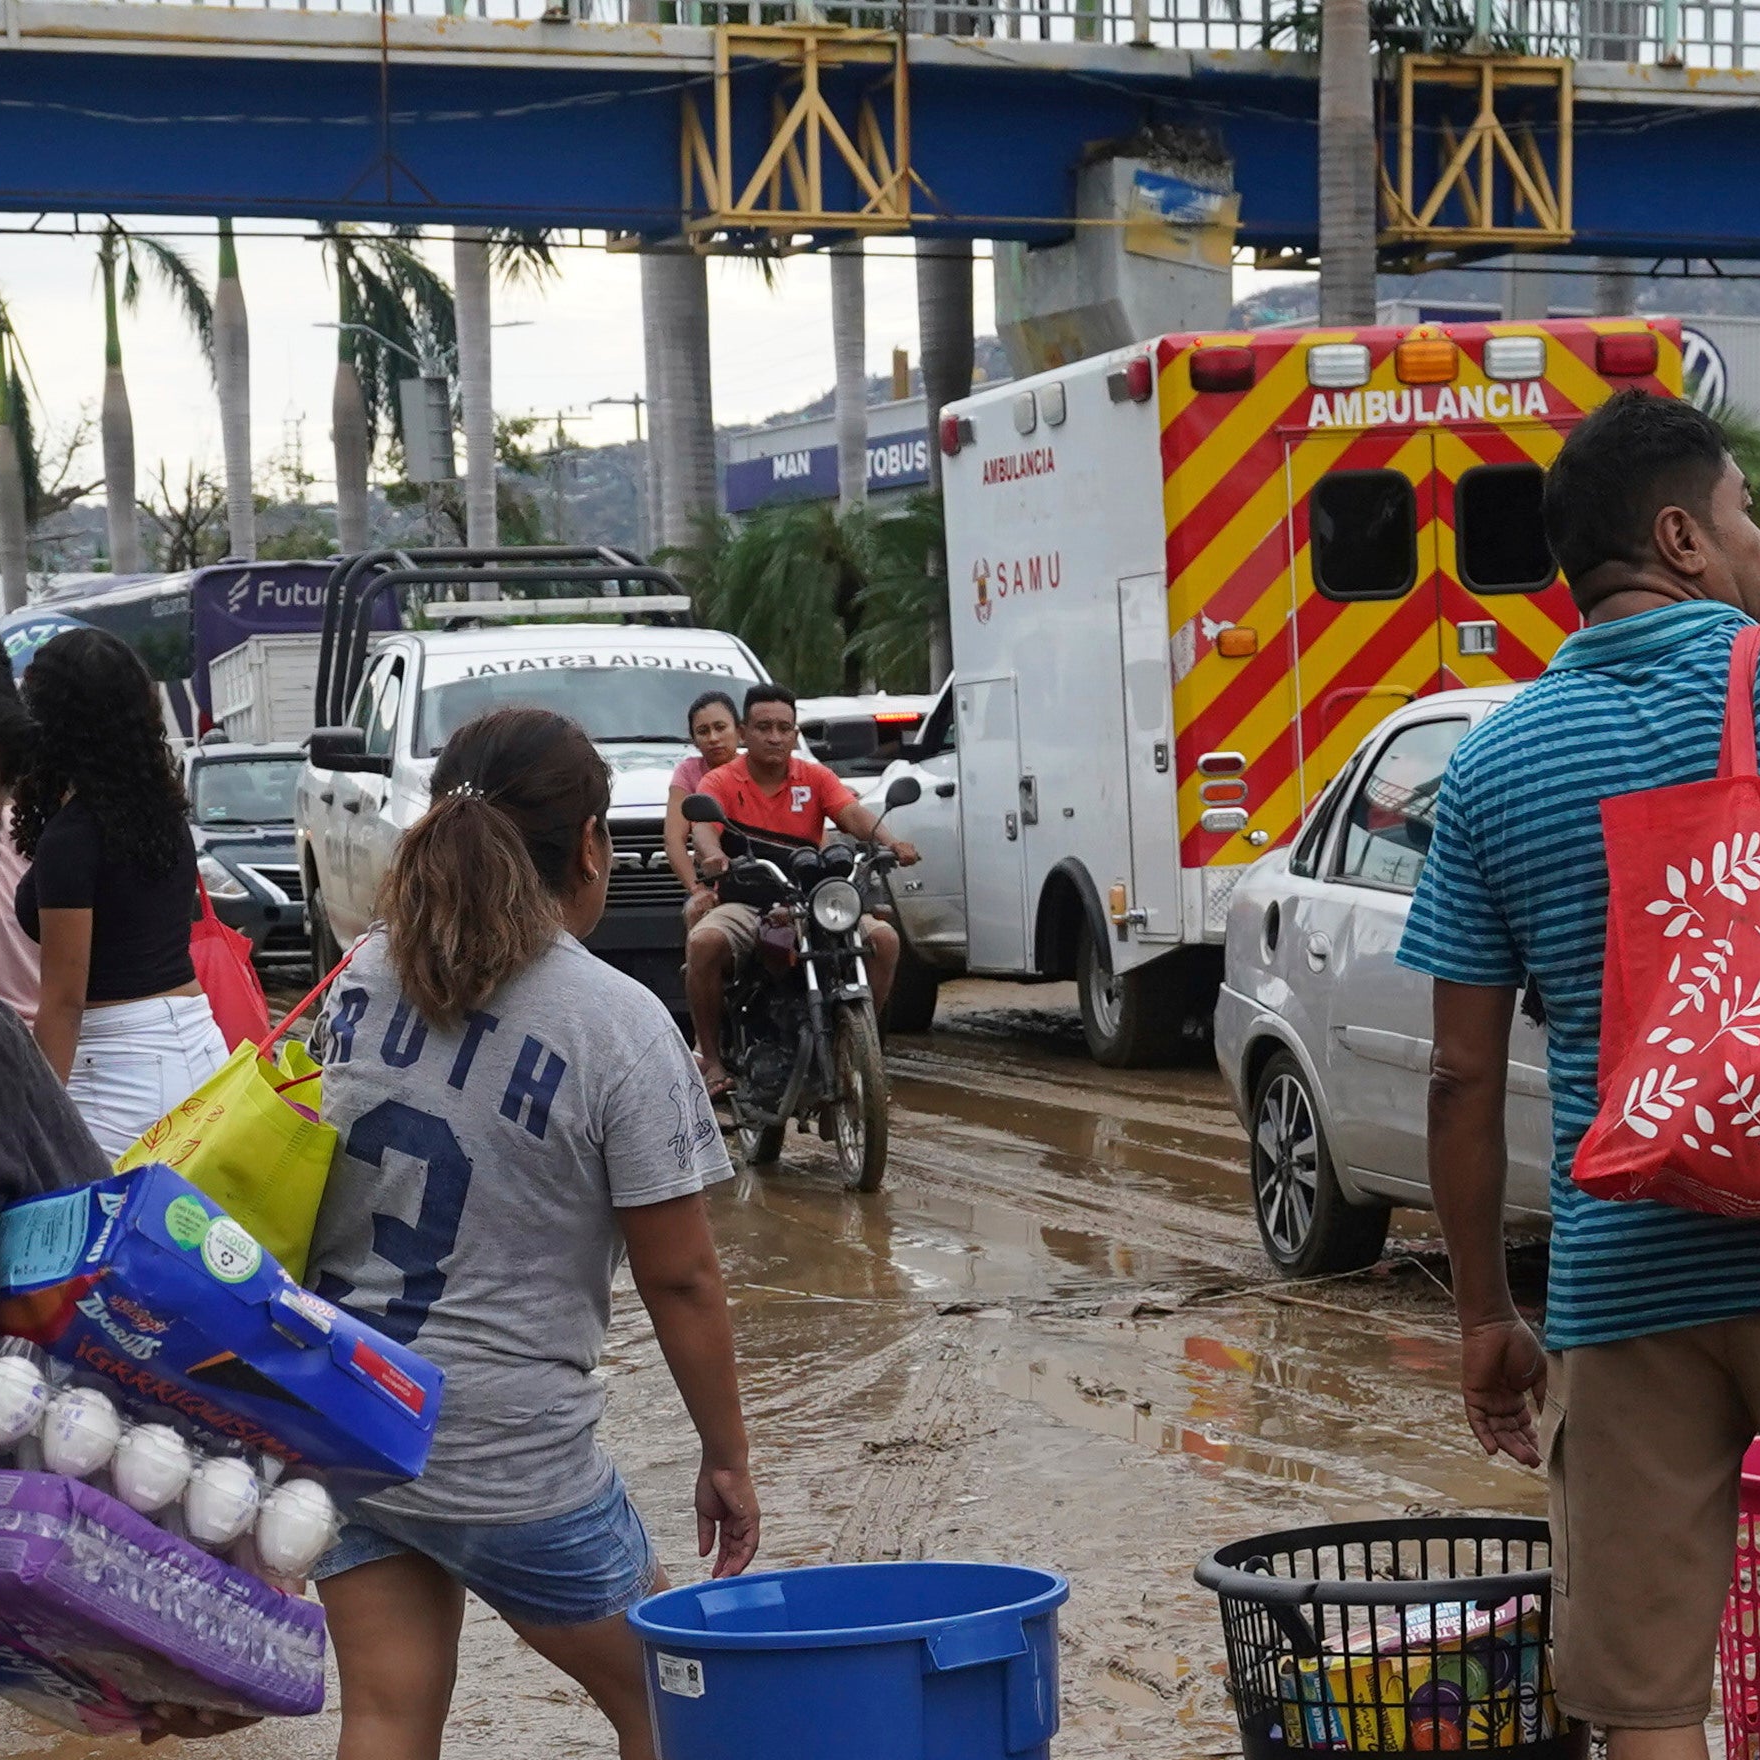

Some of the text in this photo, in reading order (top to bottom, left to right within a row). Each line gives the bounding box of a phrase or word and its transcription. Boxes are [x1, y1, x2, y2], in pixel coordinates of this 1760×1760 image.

[1308, 382, 1549, 428] AMBULANCIA
[772, 451, 811, 480] MAN
[982, 446, 1056, 485] AMBULANCIA
[257, 581, 346, 607] Futur
[996, 551, 1061, 598] SAMU
[790, 785, 812, 813] P
[328, 986, 567, 1140] RUTH
[314, 1100, 473, 1345] 3
